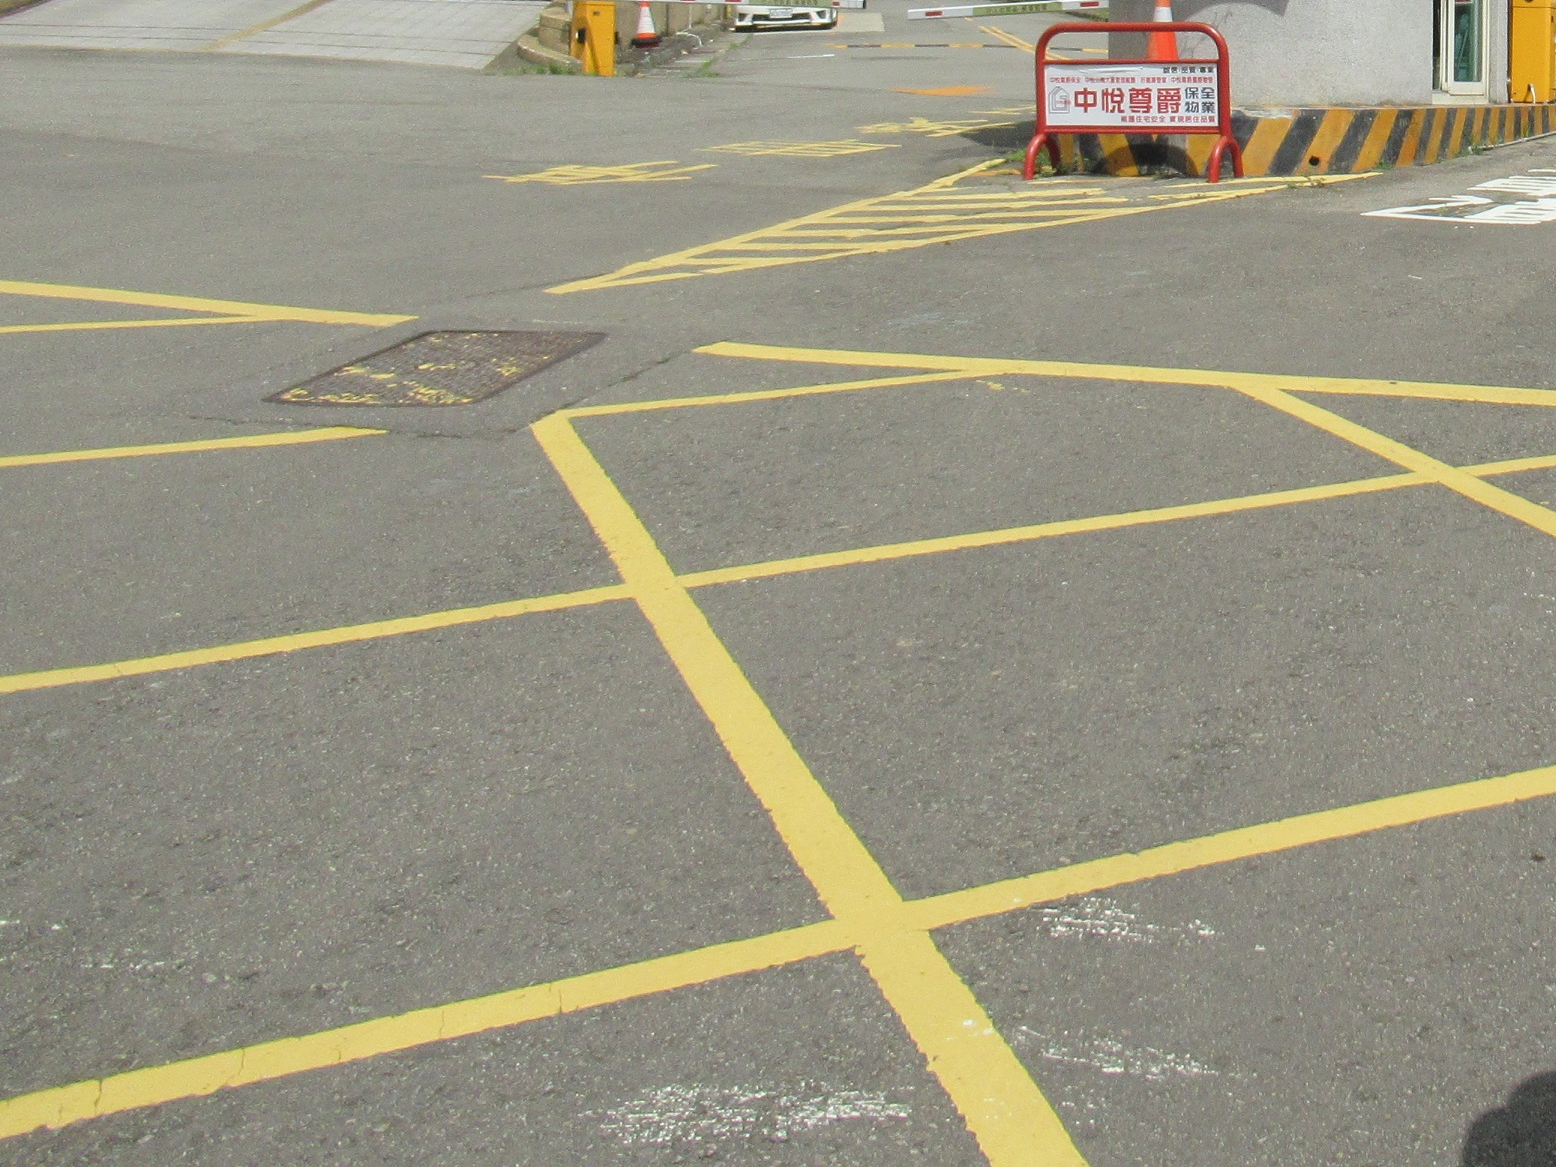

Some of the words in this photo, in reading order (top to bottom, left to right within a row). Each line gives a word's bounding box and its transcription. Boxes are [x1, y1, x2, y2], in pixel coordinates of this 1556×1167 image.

[1074, 87, 1182, 114] 中悅尊爵
[1184, 86, 1216, 100] 保全
[1184, 101, 1216, 114] 物業
